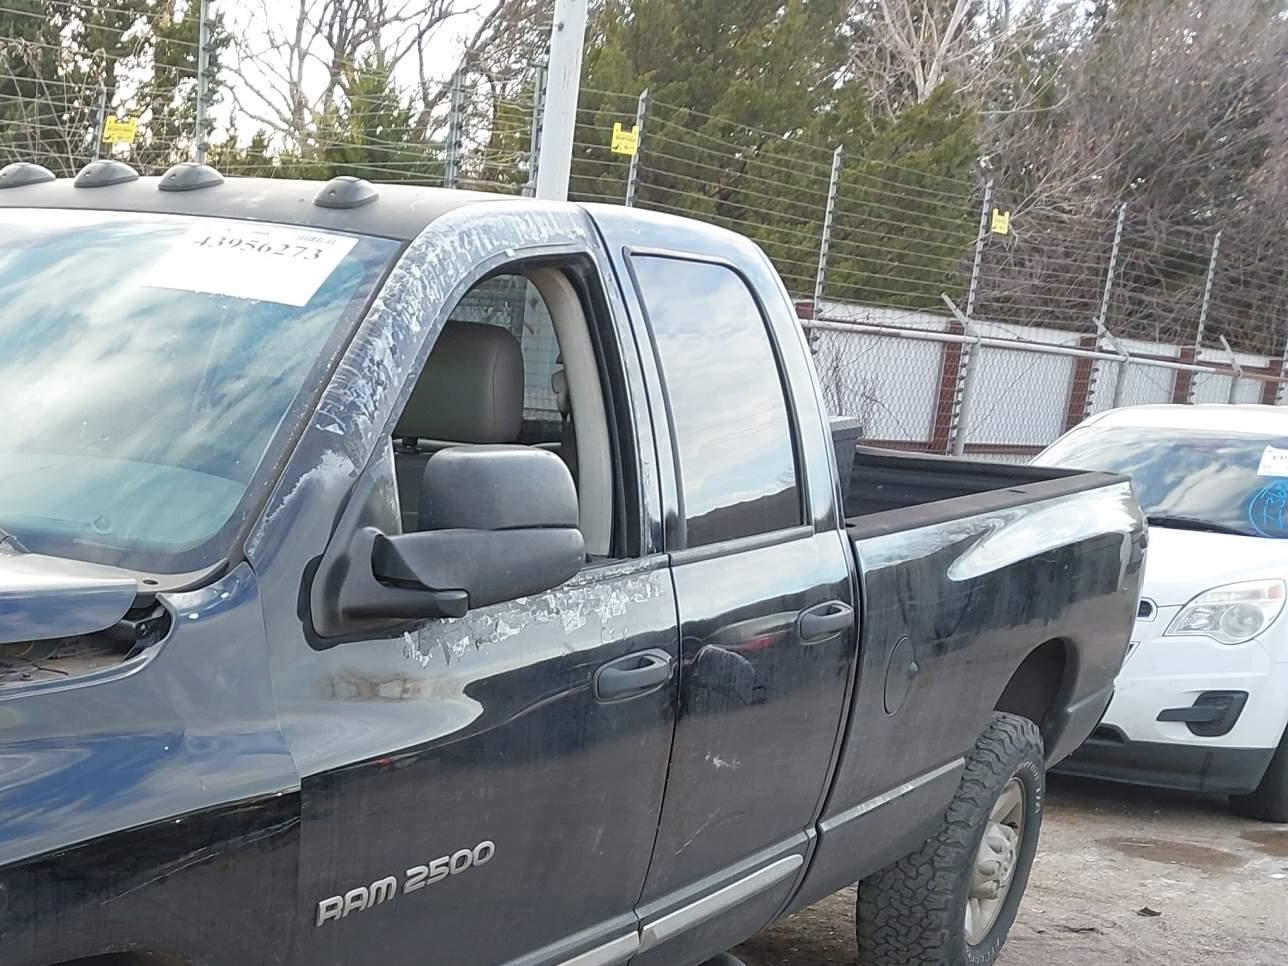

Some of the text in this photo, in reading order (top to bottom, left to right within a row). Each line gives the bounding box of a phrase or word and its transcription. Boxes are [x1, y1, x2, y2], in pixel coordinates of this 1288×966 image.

[193, 235, 323, 260] 43956273
[316, 840, 496, 928] RAM 2500
